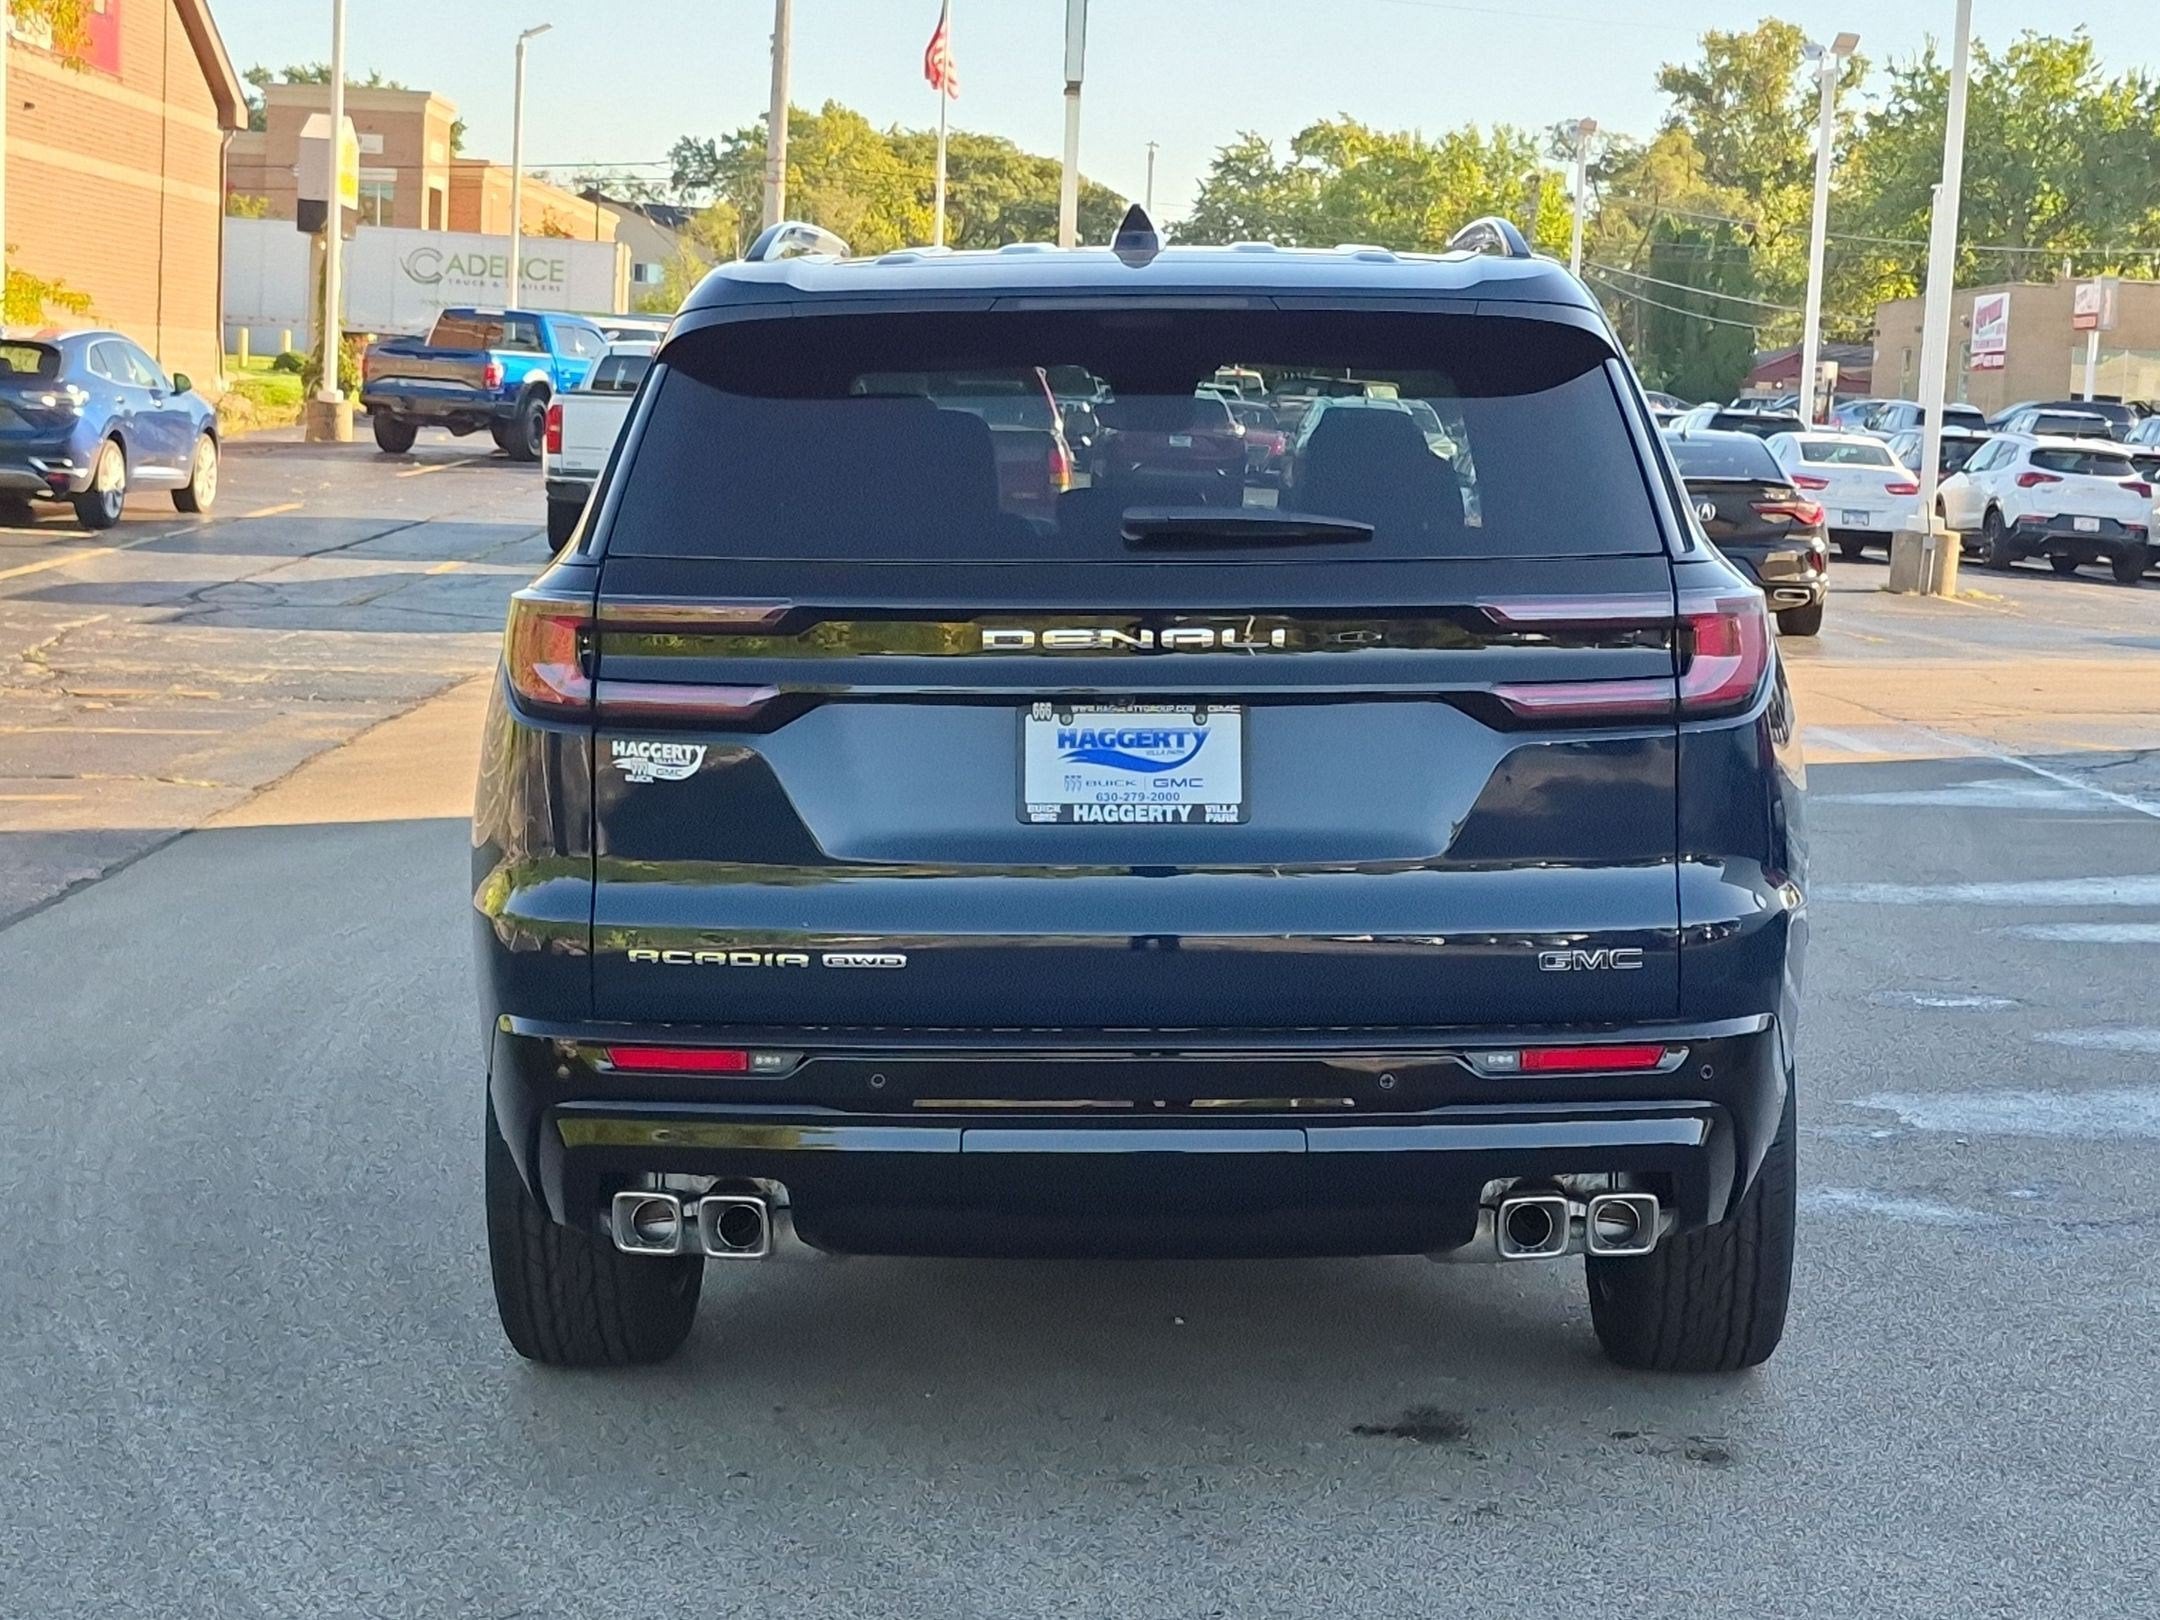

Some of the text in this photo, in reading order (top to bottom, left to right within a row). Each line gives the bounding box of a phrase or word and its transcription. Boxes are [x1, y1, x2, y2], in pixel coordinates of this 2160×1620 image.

[400, 247, 565, 284] CADENCE
[505, 281, 561, 292] TAILERS
[981, 628, 1286, 649] DENALI
[1207, 704, 1242, 713] GMC
[1057, 727, 1212, 749] HAGGERTY
[611, 740, 708, 761] HAGGERTY
[1085, 778, 1204, 788] BUICK GMC
[1096, 792, 1180, 802] 630-279-2000
[1073, 804, 1194, 823] HAGGERTY
[1204, 804, 1239, 814] VILLA
[1205, 813, 1239, 823] PARK
[627, 949, 907, 969] ACADIA AWD
[1538, 948, 1643, 971] GMC
